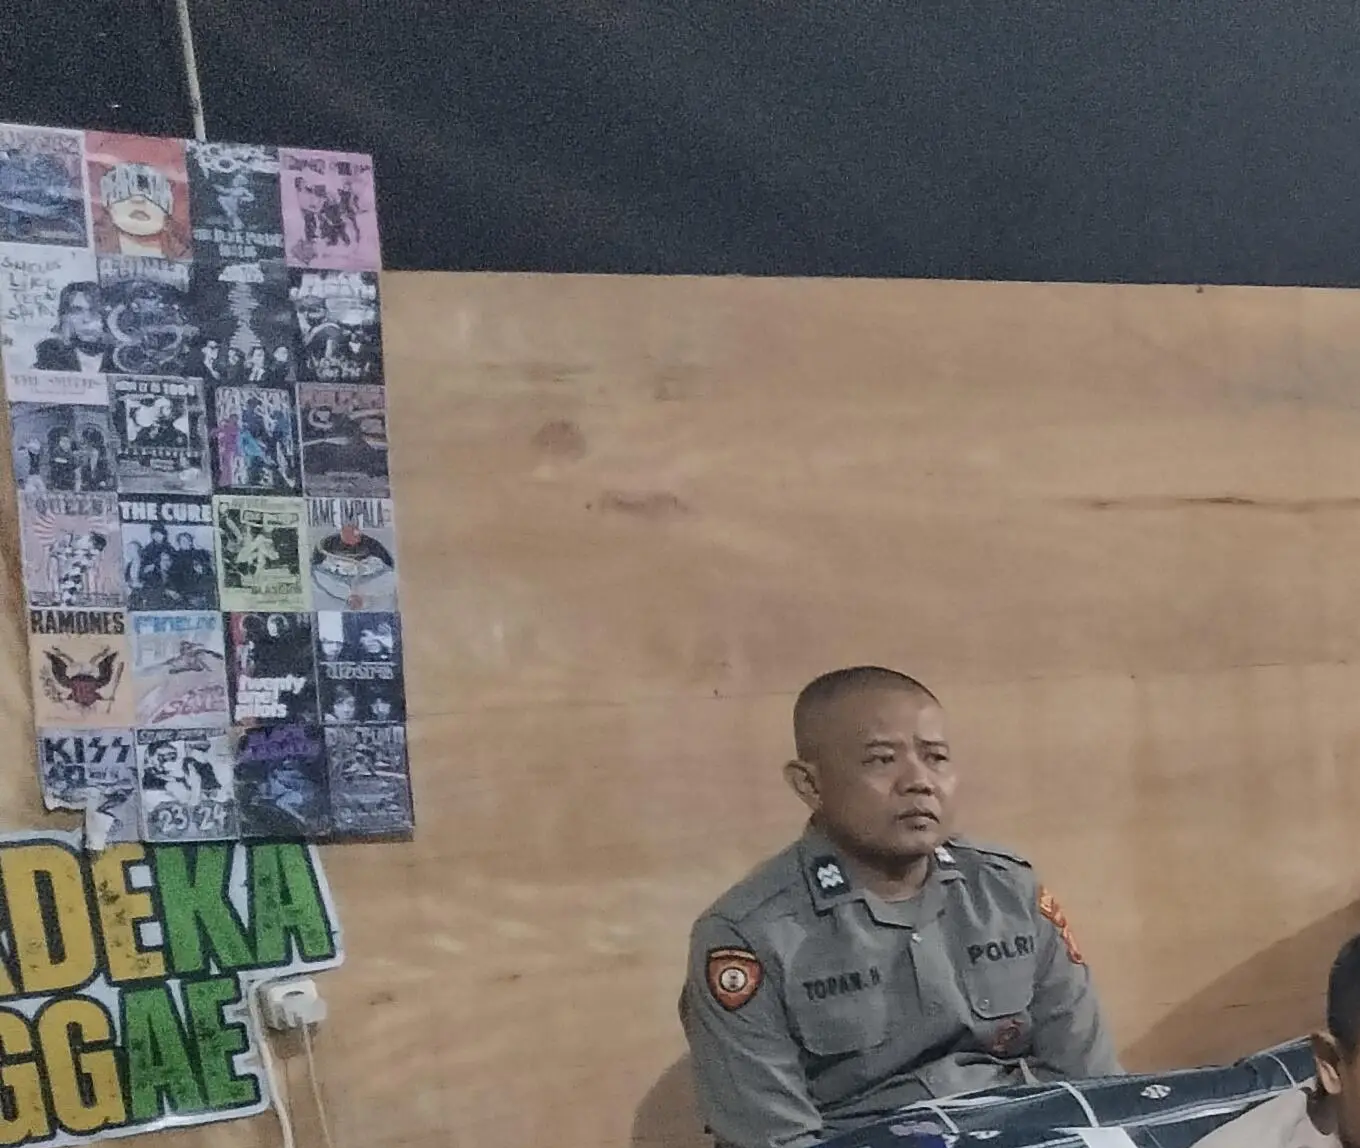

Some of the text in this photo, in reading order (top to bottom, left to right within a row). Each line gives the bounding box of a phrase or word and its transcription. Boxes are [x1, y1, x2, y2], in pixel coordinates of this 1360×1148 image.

[121, 501, 212, 522] THE CURE
[31, 611, 125, 634] RAMONES
[44, 737, 130, 763] KISS
[158, 806, 228, 831] 23 24
[0, 841, 338, 998] DEKA
[967, 935, 1035, 966] POLRI
